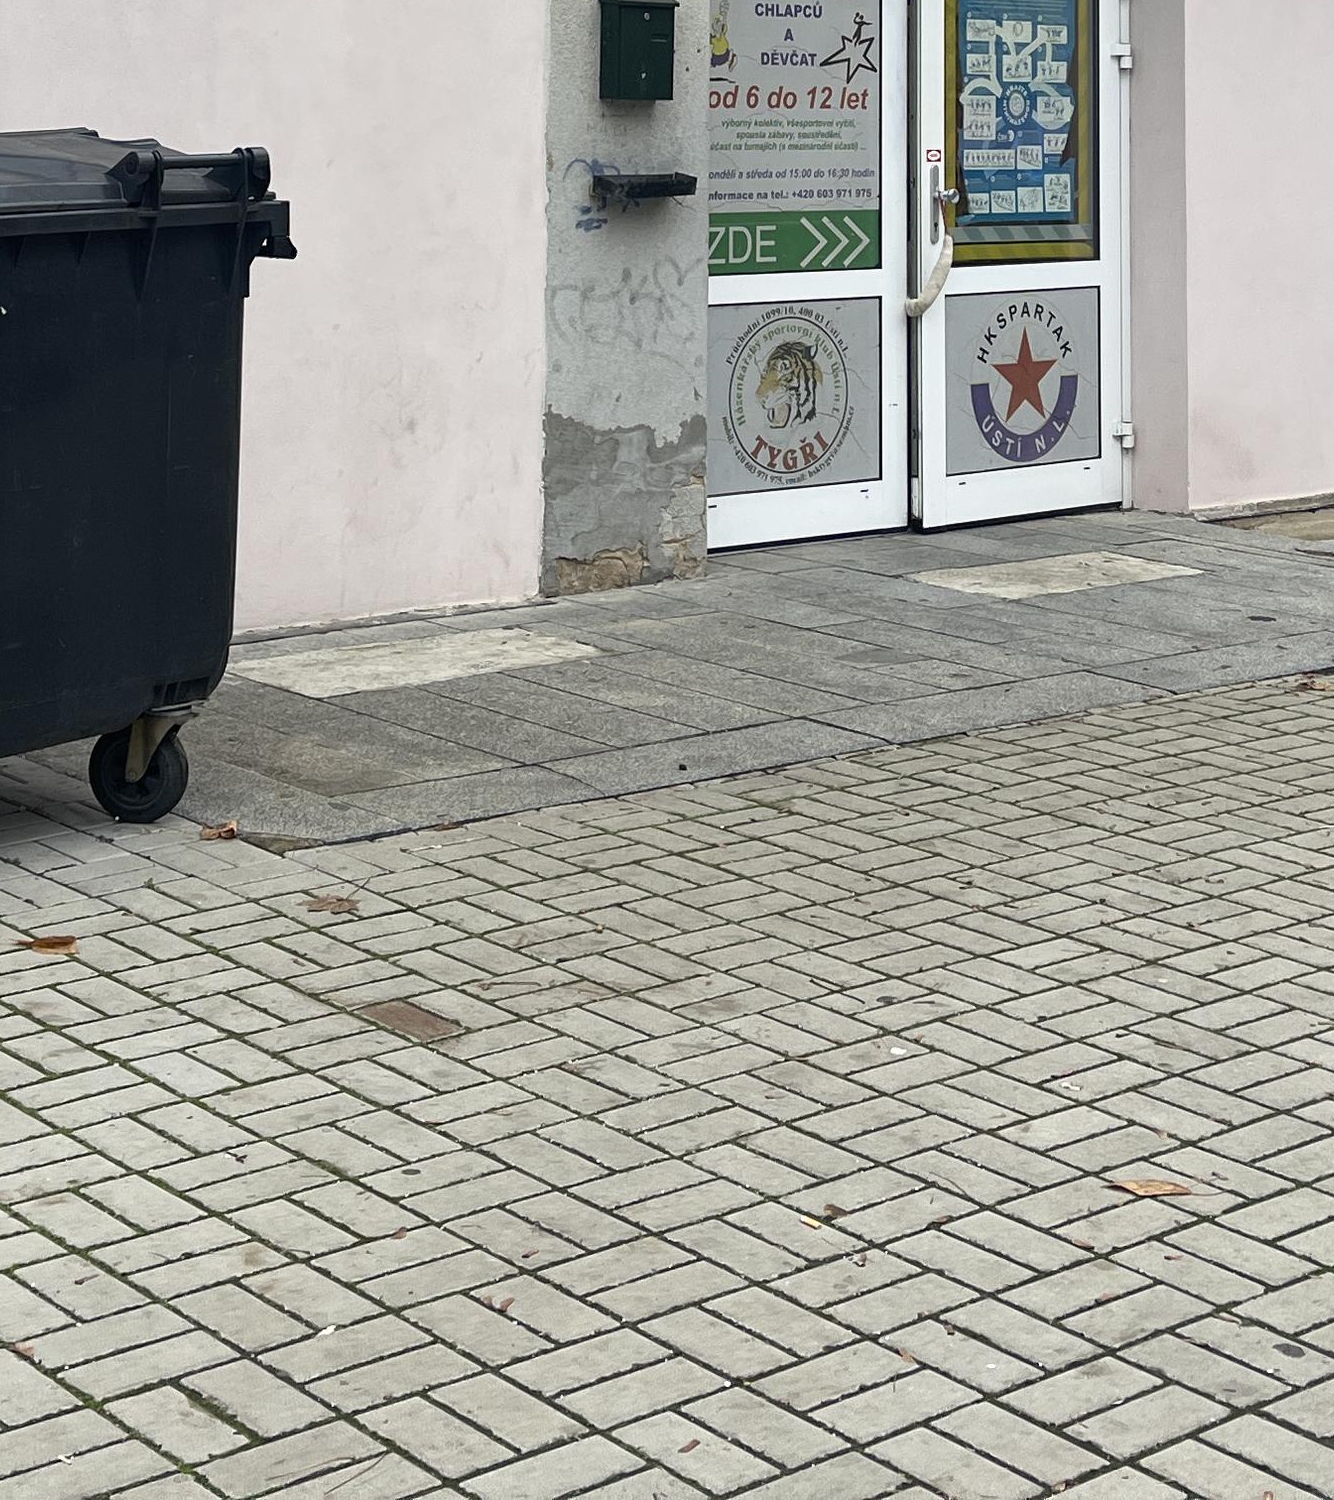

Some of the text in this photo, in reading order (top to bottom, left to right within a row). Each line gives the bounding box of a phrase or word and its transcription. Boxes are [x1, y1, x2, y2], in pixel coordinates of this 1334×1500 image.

[754, 1, 823, 19] CHLAPCŮ
[784, 28, 794, 42] A
[760, 50, 818, 67] DĚVČAT
[709, 85, 869, 110] od 6 do 12 let
[746, 169, 773, 179] středa
[776, 169, 787, 179] od
[813, 169, 825, 179] do
[851, 168, 875, 178] hodin
[756, 191, 768, 200] na
[792, 190, 815, 199] +420
[817, 189, 834, 199] 603
[836, 189, 852, 199] 971
[854, 188, 872, 198] 975
[709, 225, 777, 265] ZDE
[977, 301, 1072, 364] HK SPARTAK
[981, 414, 1022, 459] ÚSTÍ
[750, 431, 829, 471] TYGŘI
